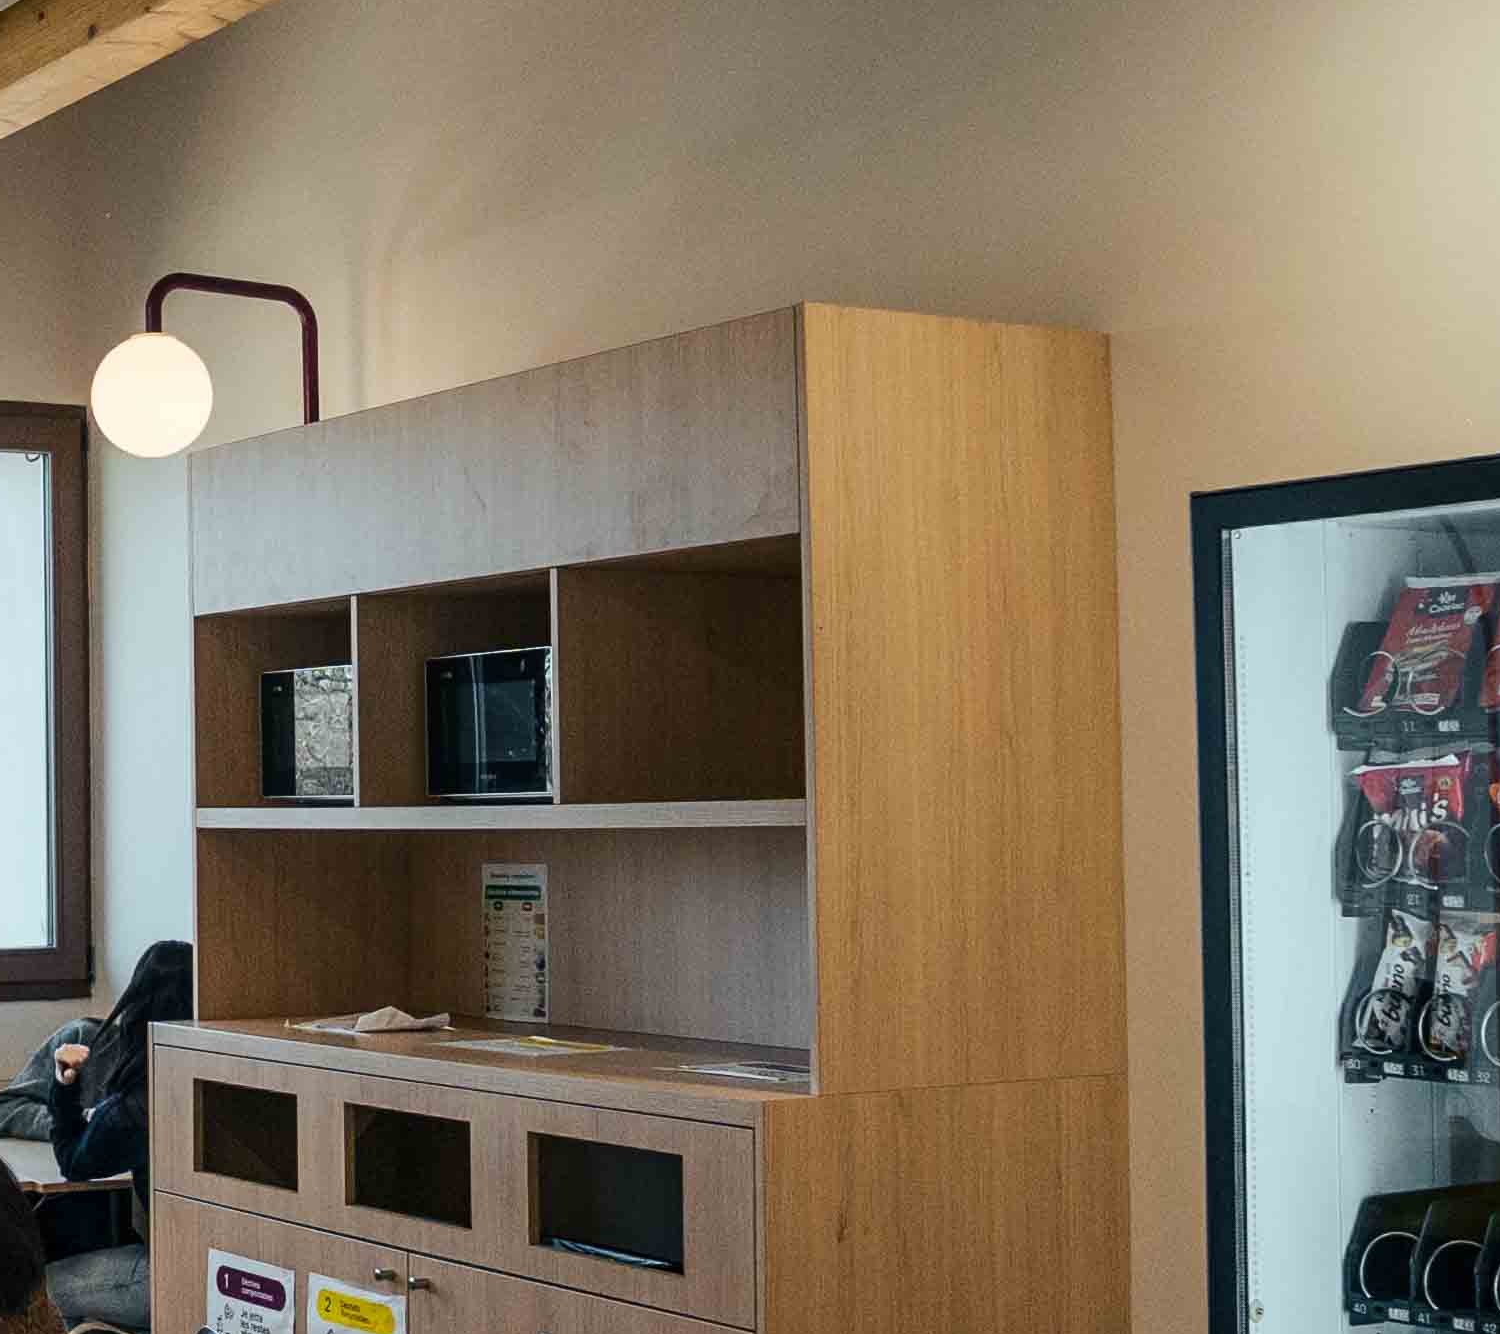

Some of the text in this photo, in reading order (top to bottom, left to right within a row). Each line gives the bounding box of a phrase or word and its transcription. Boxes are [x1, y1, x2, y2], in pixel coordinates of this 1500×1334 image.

[224, 1273, 229, 1289] 1
[325, 1296, 331, 1312] 2
[1352, 1302, 1367, 1315] 40
[1417, 1313, 1430, 1324] 41
[1483, 1322, 1497, 1334] 42
